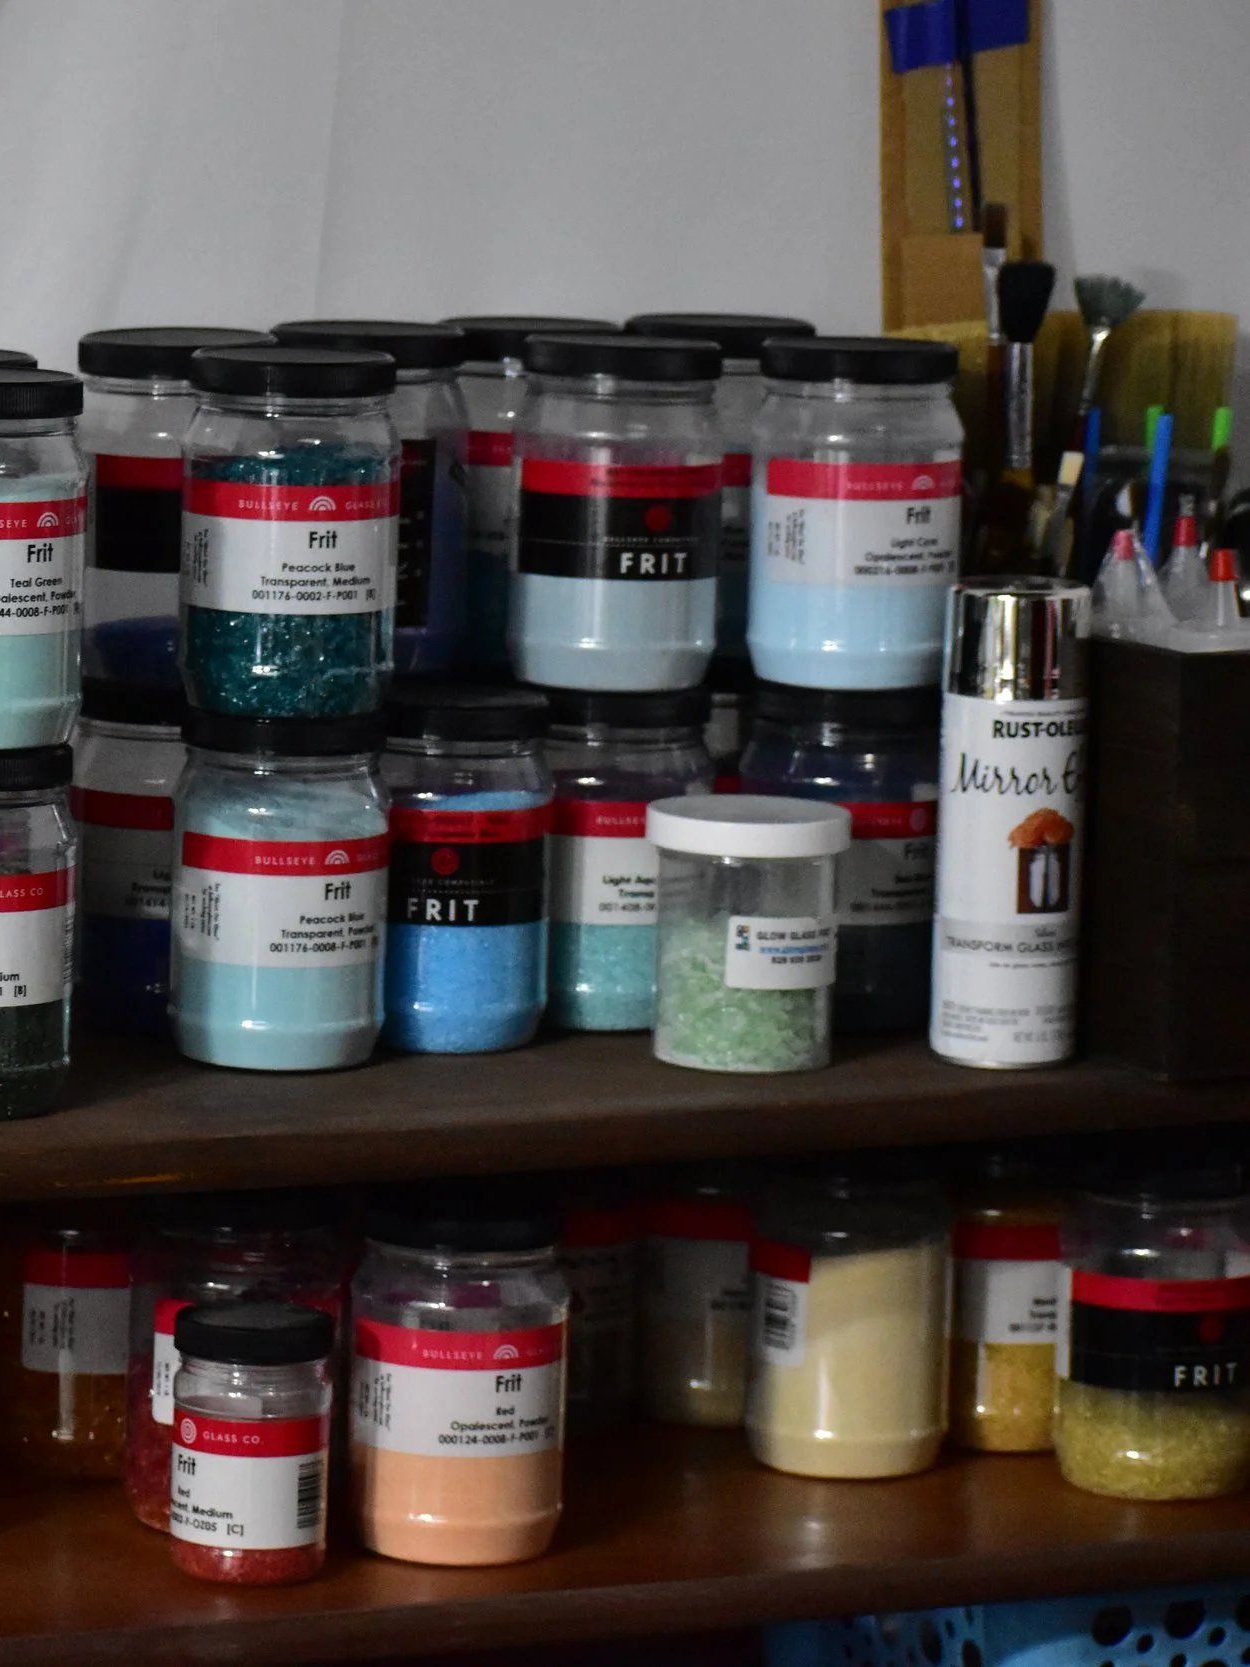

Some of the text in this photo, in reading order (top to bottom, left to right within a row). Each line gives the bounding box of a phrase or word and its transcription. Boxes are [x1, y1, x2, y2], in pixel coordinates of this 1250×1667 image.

[238, 500, 298, 511] BULLSEYE
[906, 506, 931, 524] Frit
[309, 531, 337, 549] Frit
[27, 543, 53, 563] Frit
[282, 563, 356, 573] Peacock Blue
[620, 552, 688, 575] FRIT
[10, 577, 63, 588] Teal Green
[261, 576, 371, 587] Transparent, Medium
[252, 590, 358, 601] 001176-0002-F-P001
[992, 720, 1079, 738] RUST-OLE
[950, 751, 1058, 795] Mirror
[254, 855, 316, 865] BULLSEYE
[29, 887, 44, 896] CO
[325, 881, 352, 901] Frit
[407, 898, 480, 921] FRIT
[300, 914, 345, 925] Peacock
[281, 929, 344, 940] Transparent,
[423, 1349, 483, 1360] BULLSEYE
[1173, 1363, 1237, 1388] FRIT
[496, 1374, 522, 1393] Frit
[496, 1407, 515, 1416] Red
[451, 1420, 514, 1432] Opalescent,
[202, 1430, 237, 1443] GLASS
[178, 1454, 197, 1476] Frit
[191, 1505, 233, 1520] Medium
[227, 1523, 244, 1537] [C]
